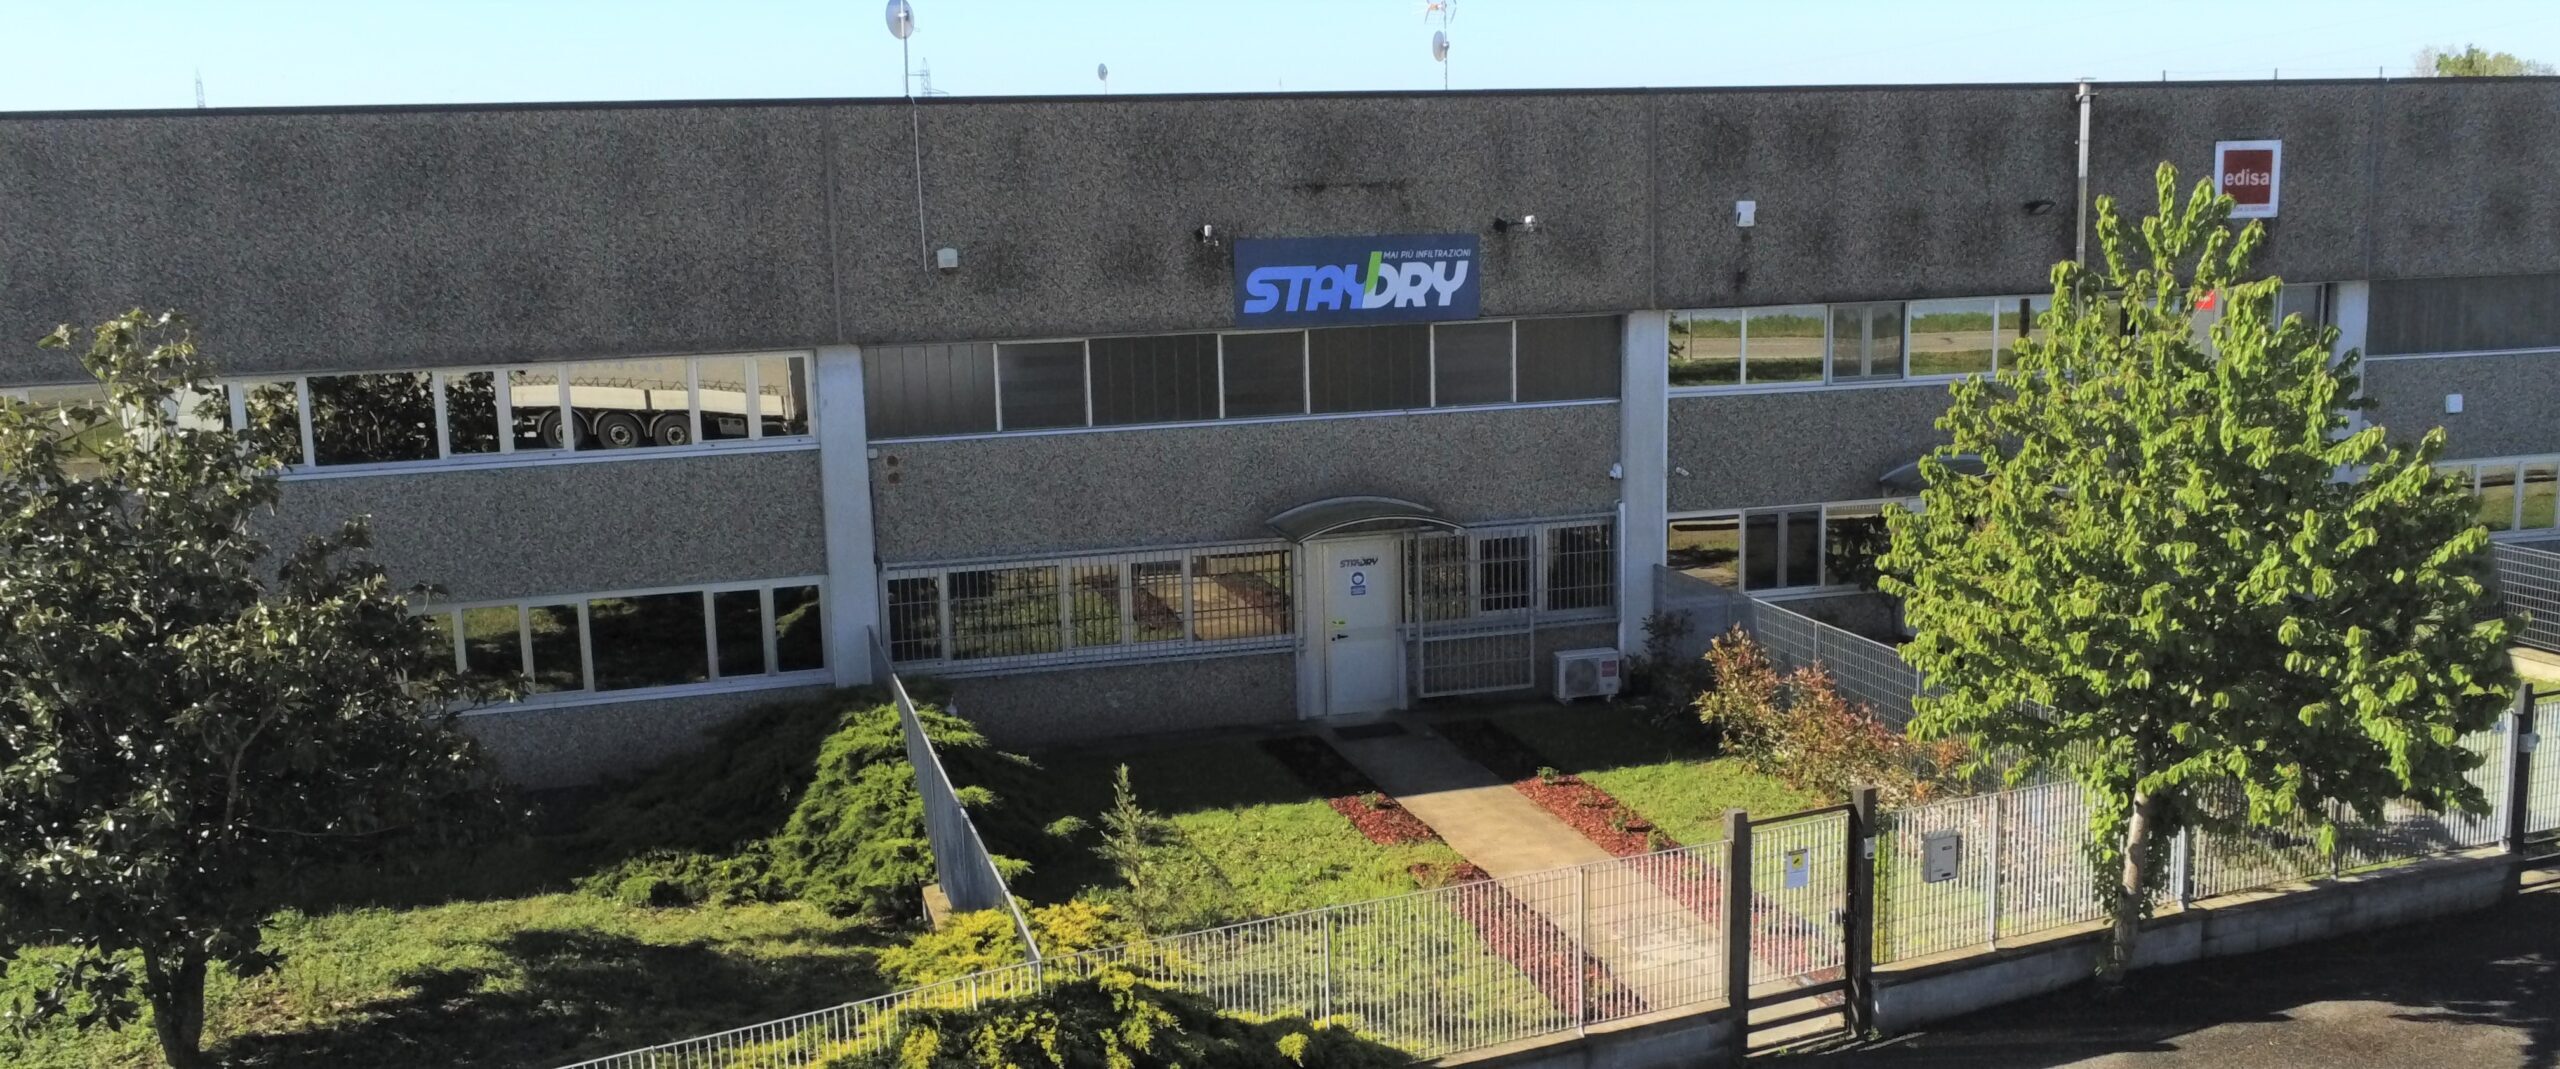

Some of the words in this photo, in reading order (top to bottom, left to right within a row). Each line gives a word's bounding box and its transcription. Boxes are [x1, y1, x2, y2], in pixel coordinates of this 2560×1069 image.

[2224, 168, 2270, 186] edisa
[1383, 251, 1399, 259] MAI
[1415, 248, 1472, 258] INFILTRAZIONI
[1243, 251, 1469, 313] STAYDRY
